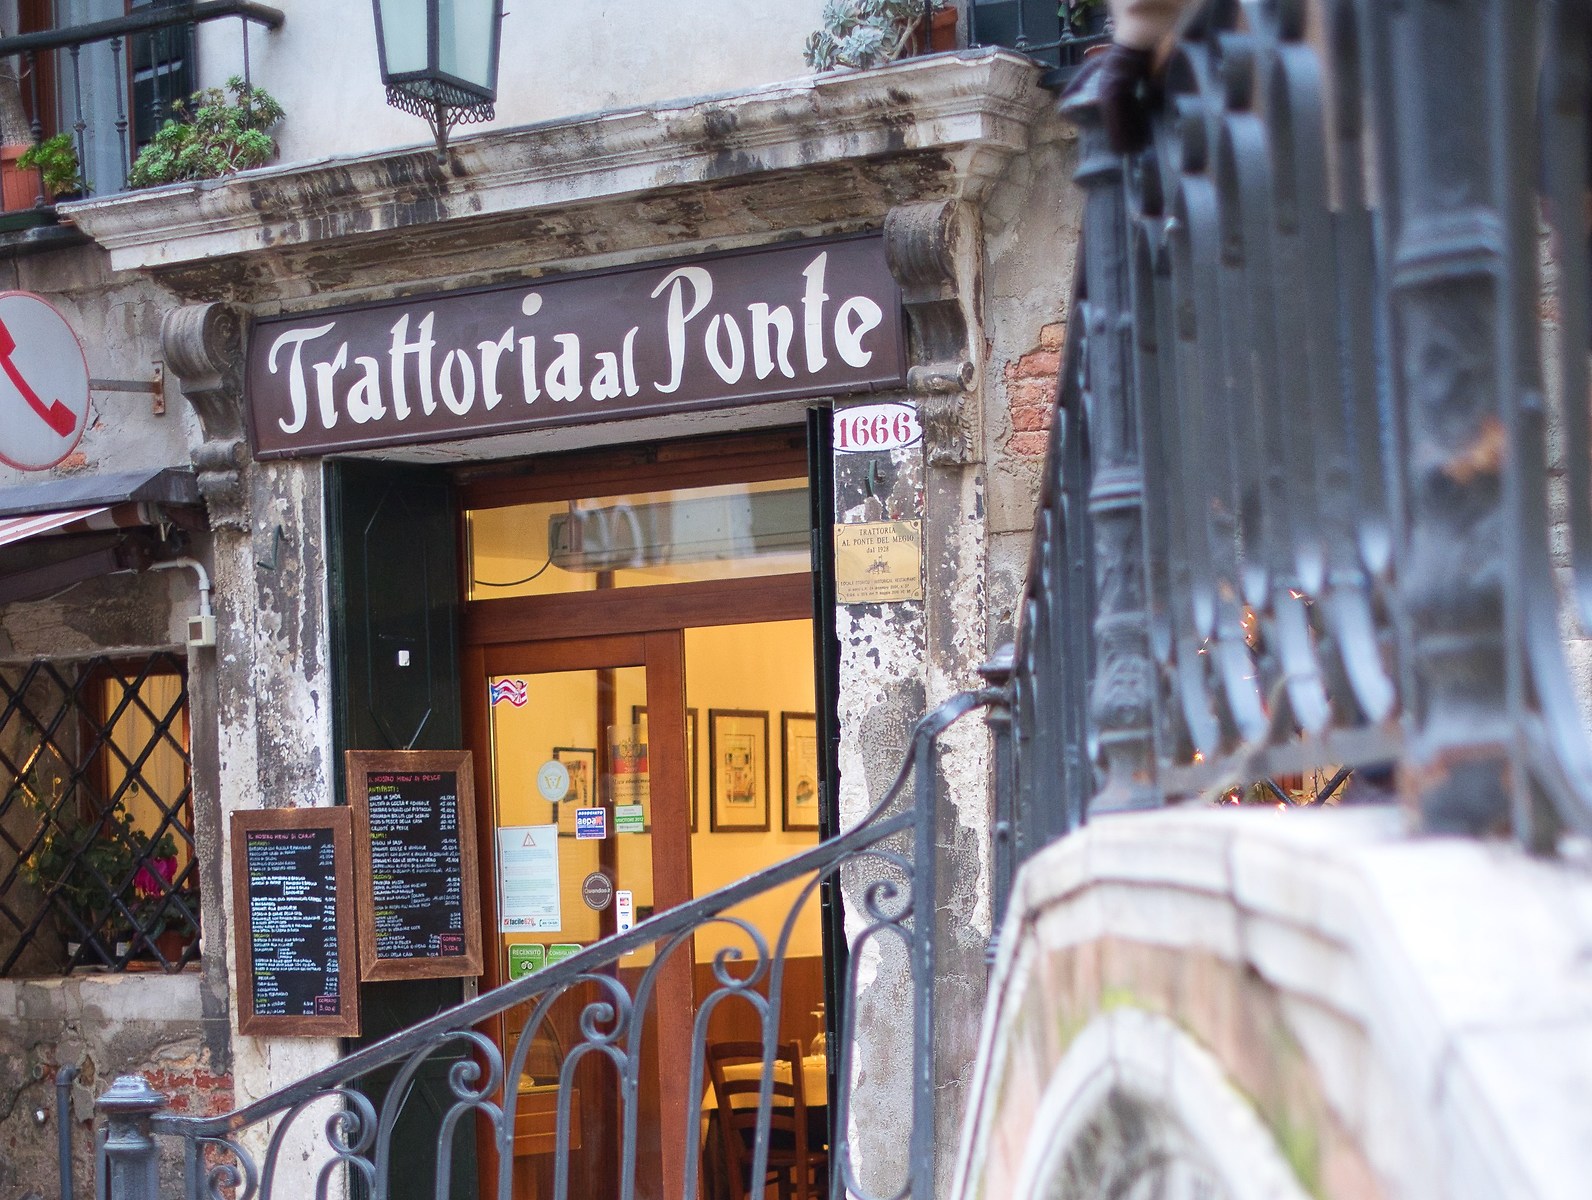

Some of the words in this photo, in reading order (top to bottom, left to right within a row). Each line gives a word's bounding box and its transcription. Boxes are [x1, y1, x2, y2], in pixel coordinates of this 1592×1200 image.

[268, 292, 584, 435] Trattoria
[590, 326, 640, 402] al
[650, 251, 883, 394] Ponte
[839, 412, 912, 448] 1666
[860, 527, 896, 536] TRATTORIA
[853, 537, 874, 546] PONTE
[876, 536, 890, 544] DEL
[892, 534, 915, 543] MEGIO
[866, 546, 876, 554] dal
